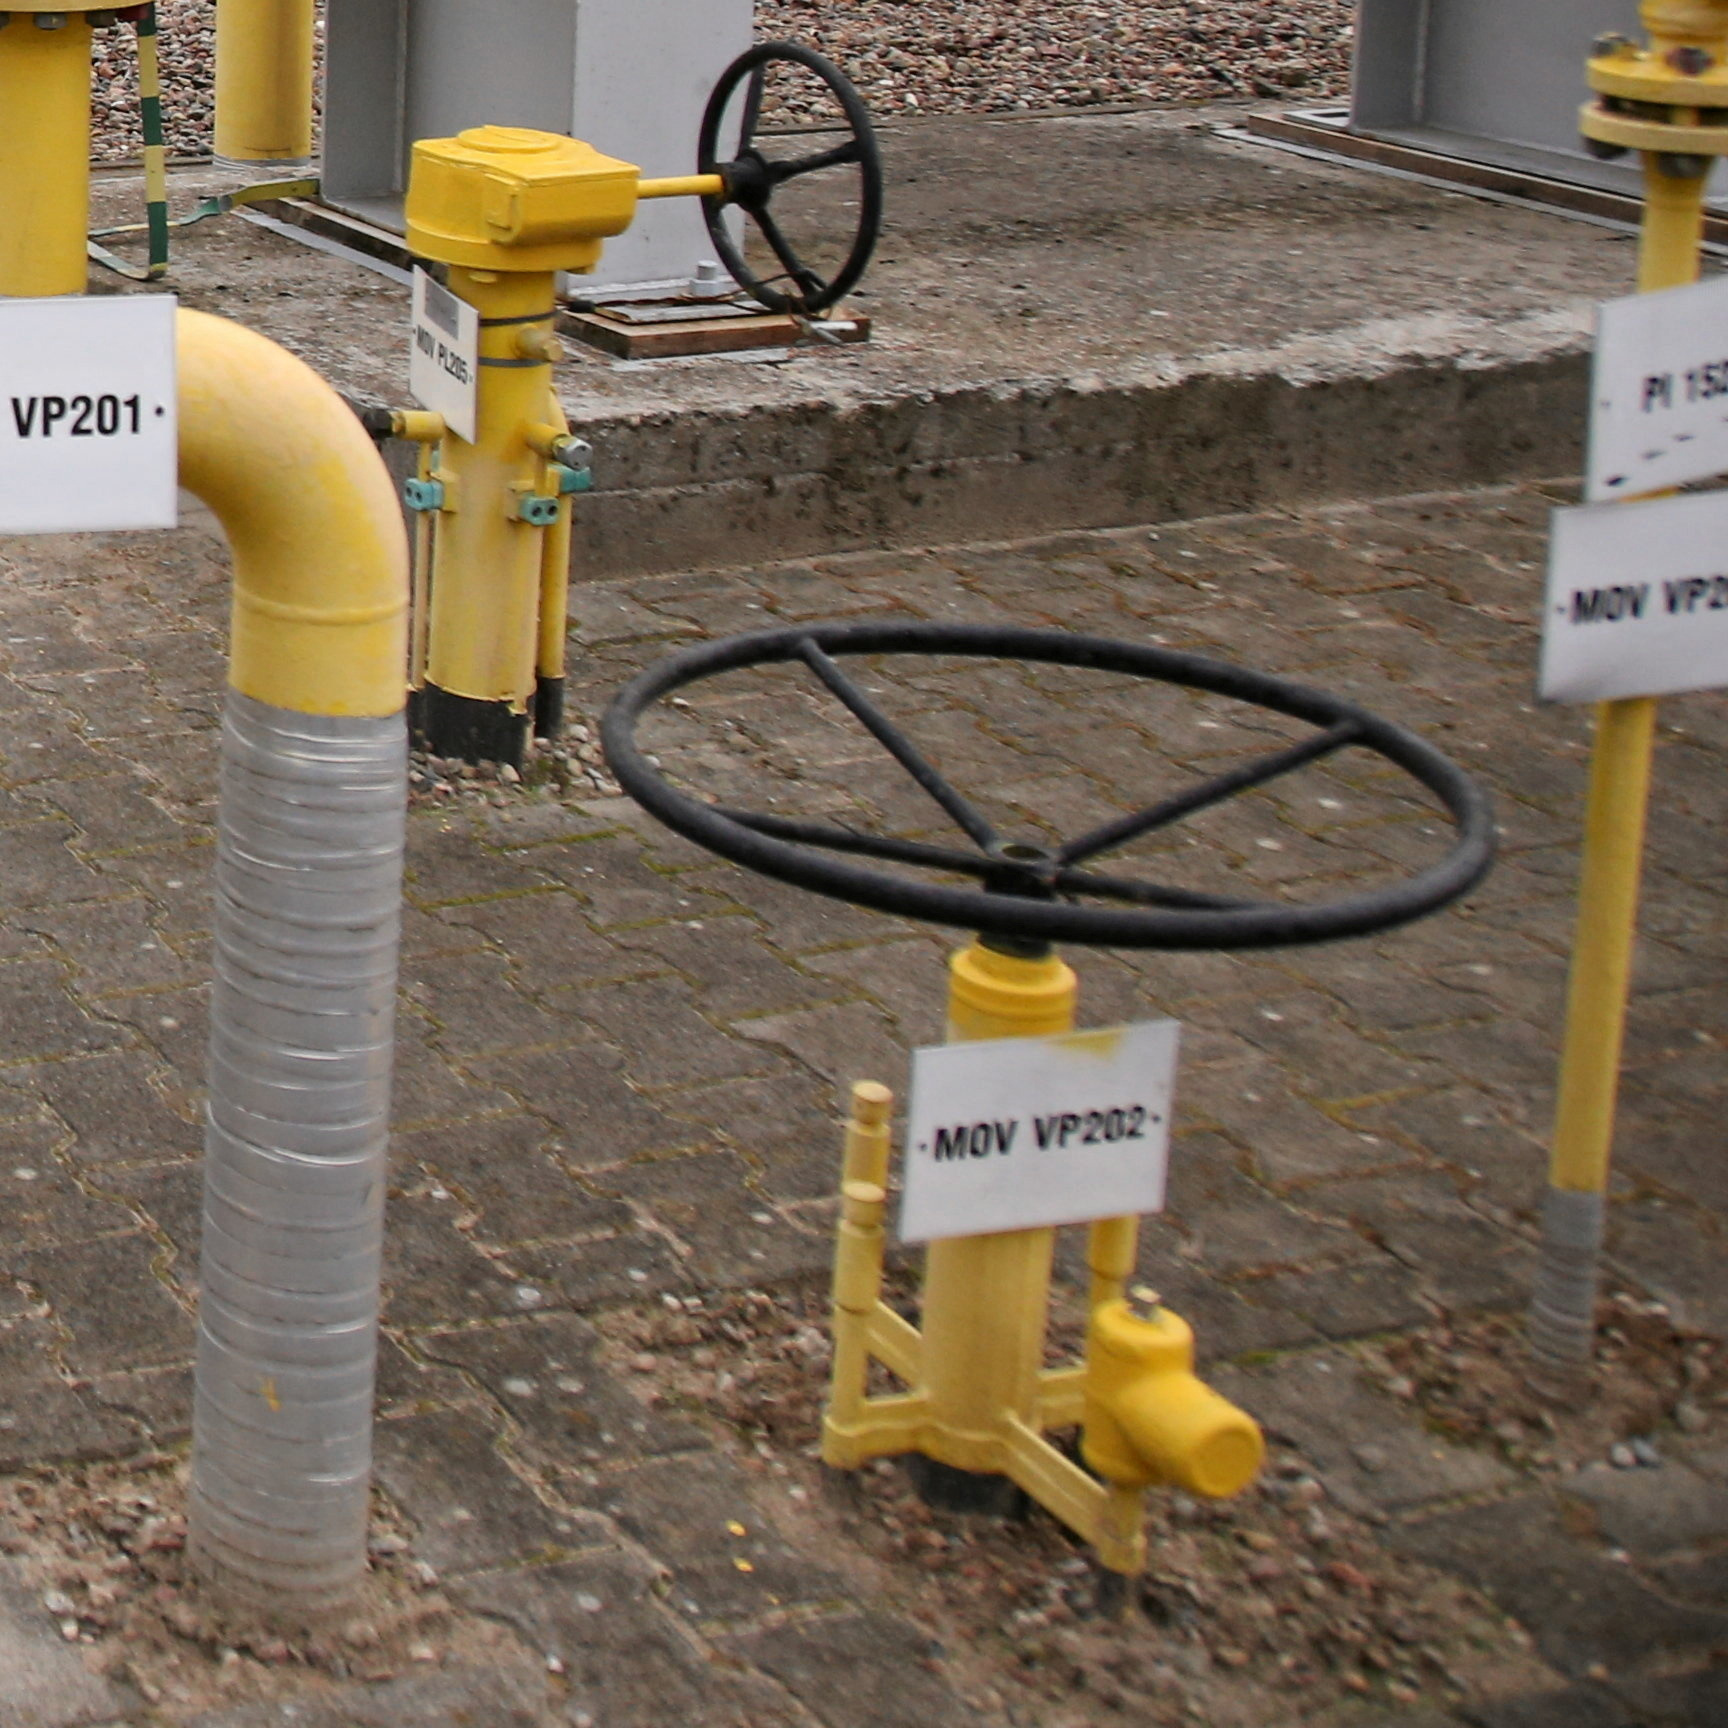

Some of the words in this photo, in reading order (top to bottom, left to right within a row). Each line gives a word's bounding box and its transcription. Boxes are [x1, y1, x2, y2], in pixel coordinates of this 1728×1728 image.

[417, 324, 436, 359] MOV
[438, 342, 469, 385] PL205
[1640, 372, 1672, 413] PI
[11, 393, 142, 438] VP201
[1570, 582, 1650, 624] MOV
[933, 1119, 1019, 1162] MOV
[1033, 1105, 1146, 1151] VP202
